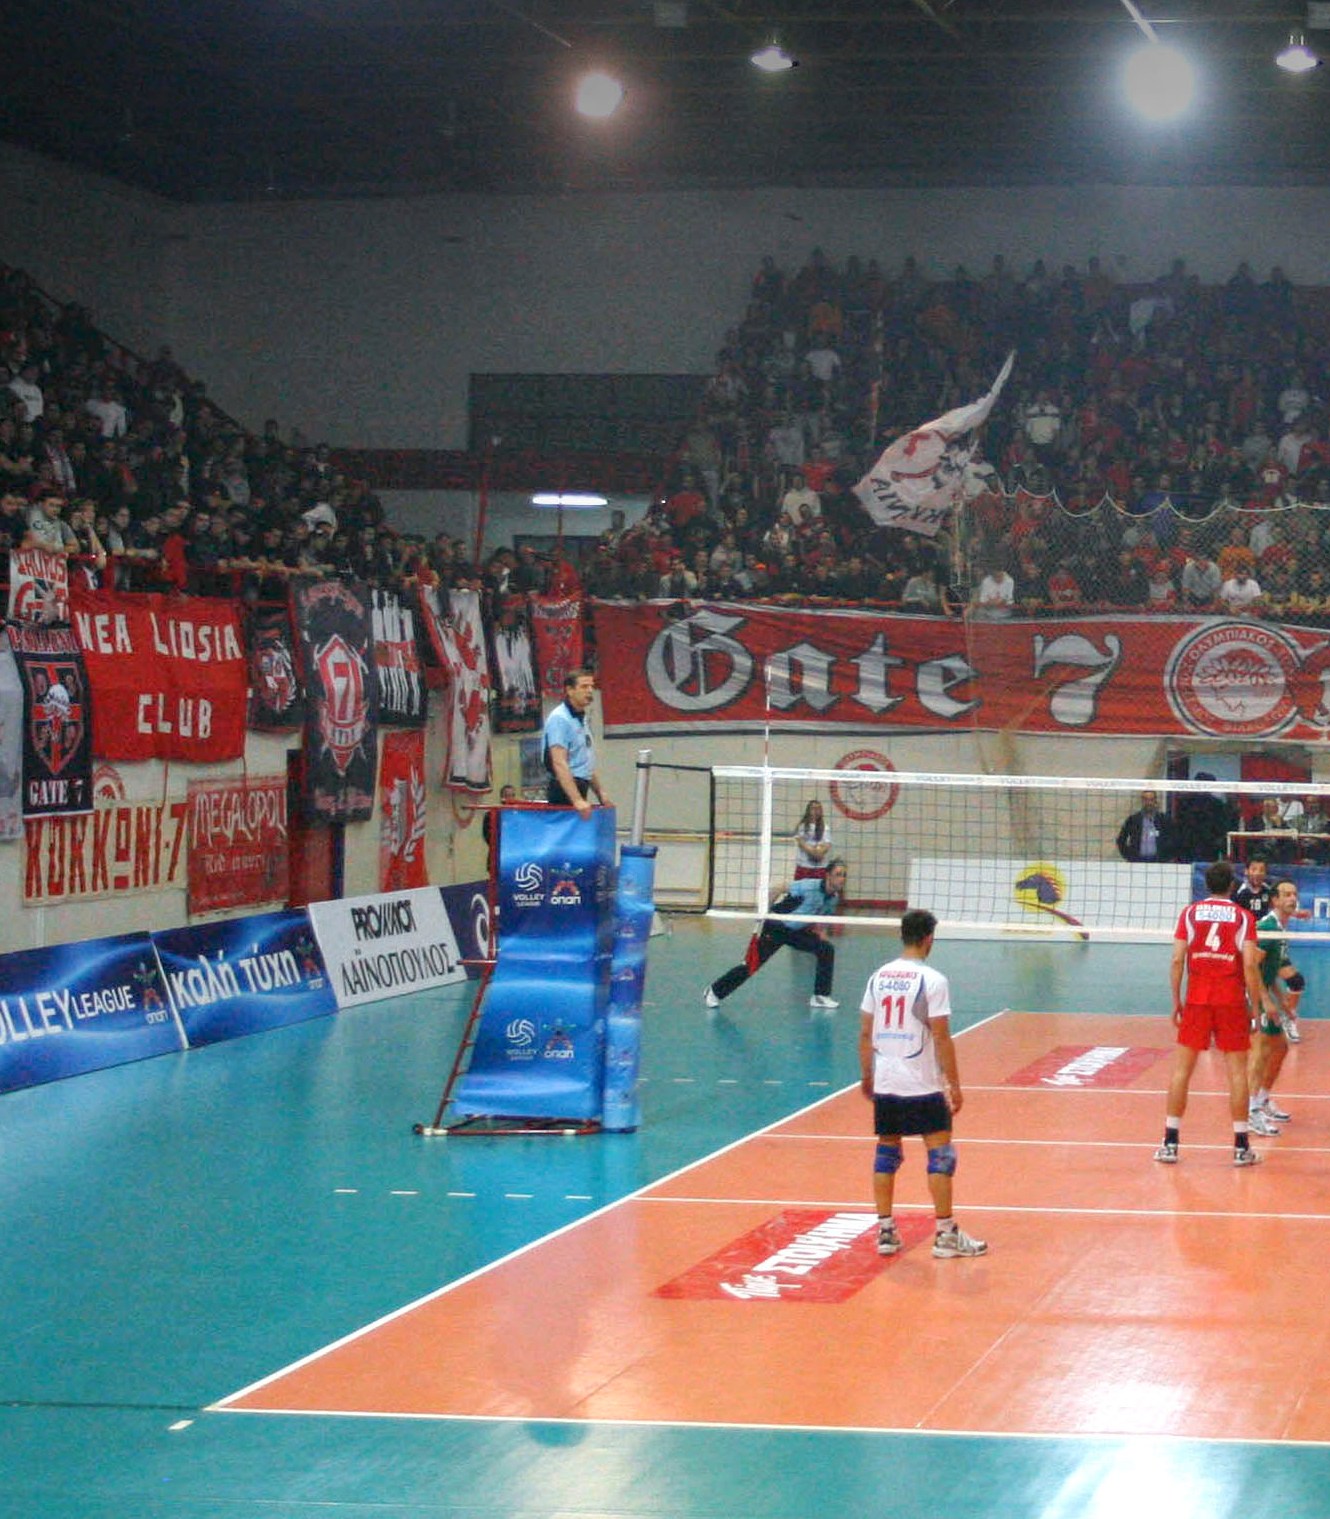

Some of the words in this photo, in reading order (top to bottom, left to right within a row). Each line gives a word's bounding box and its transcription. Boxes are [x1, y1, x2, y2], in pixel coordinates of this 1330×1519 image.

[75, 611, 132, 654] NEA
[151, 612, 243, 661] LIOSIA
[645, 606, 982, 716] Gate
[1033, 634, 1122, 727] 7
[138, 693, 212, 738] CLUB
[30, 779, 69, 806] GATE
[1204, 922, 1221, 952] 4
[72, 986, 136, 1019] LEAGUE
[881, 994, 906, 1029] 11
